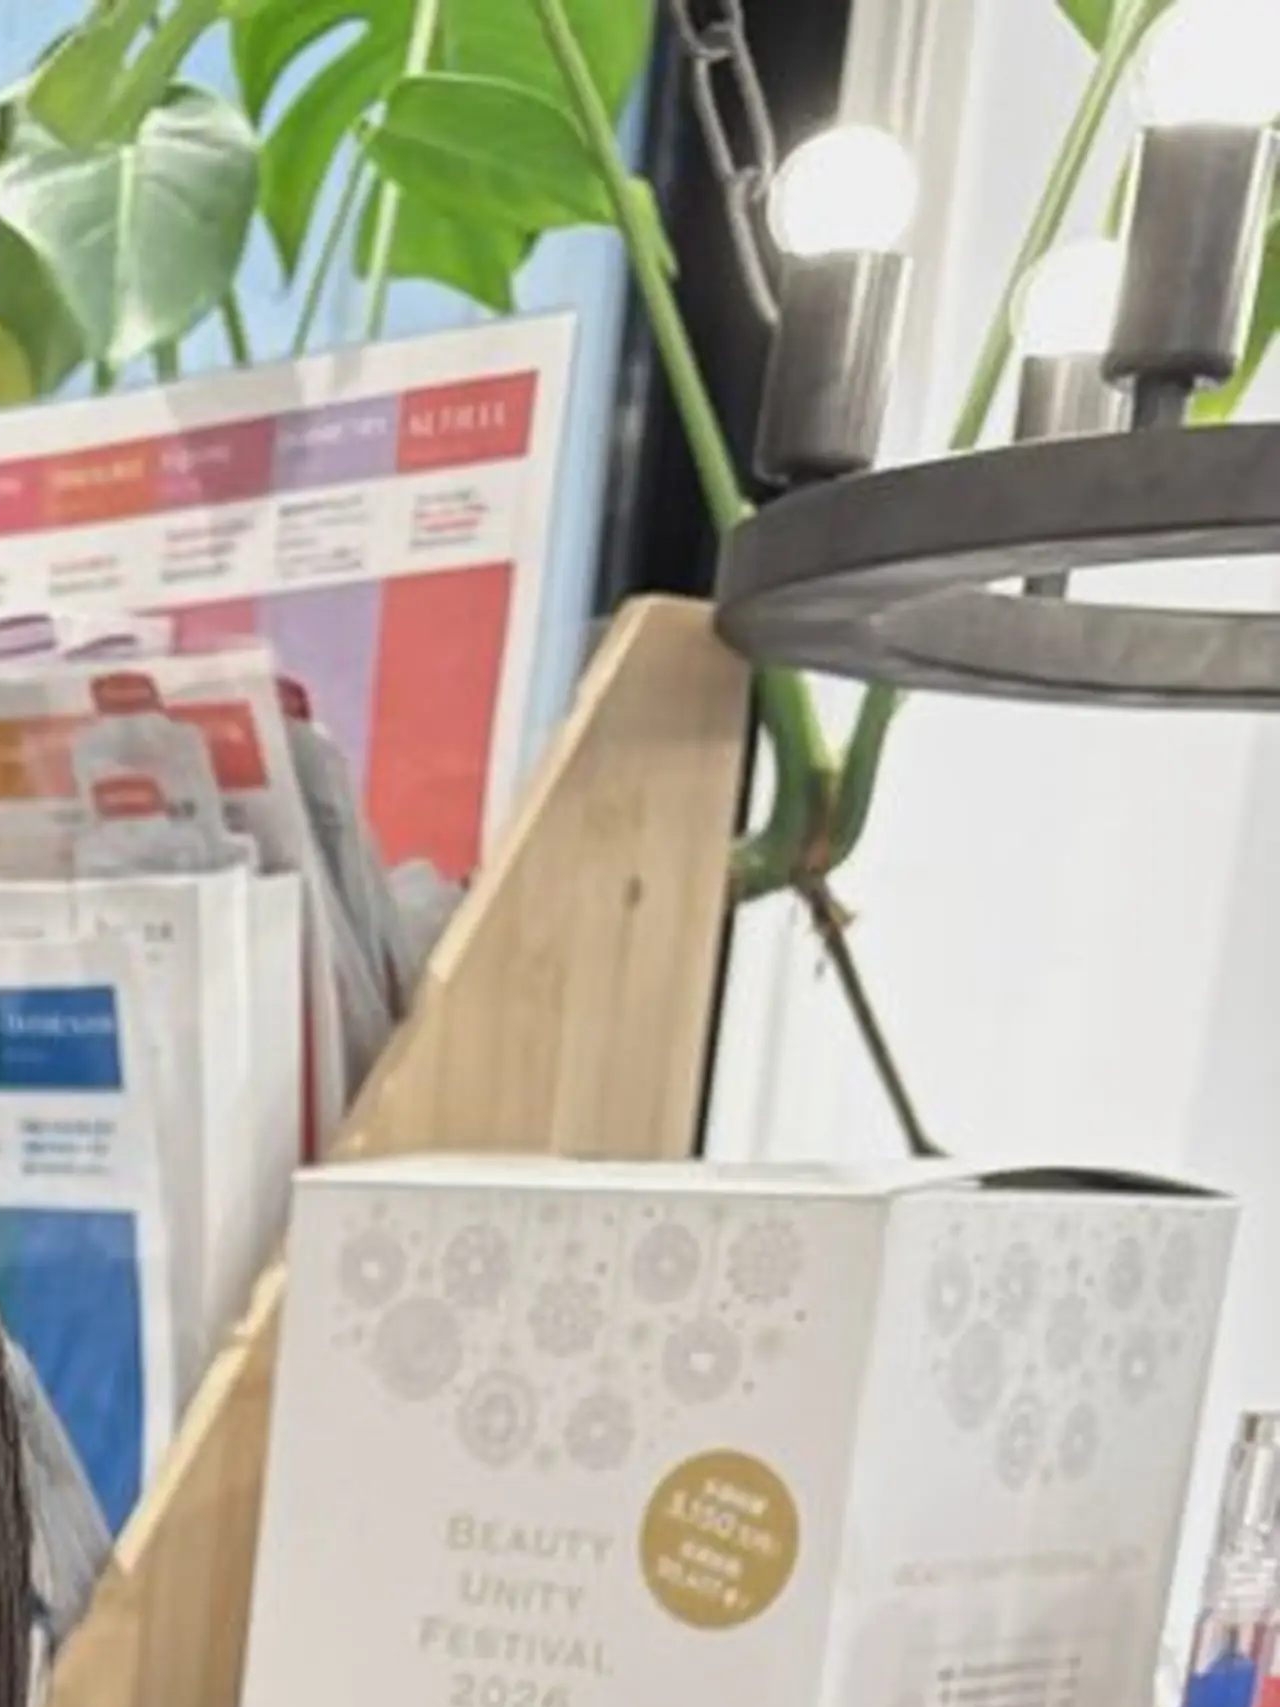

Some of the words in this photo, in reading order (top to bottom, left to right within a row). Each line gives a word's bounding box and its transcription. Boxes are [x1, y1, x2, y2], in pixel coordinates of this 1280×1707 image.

[446, 1514, 615, 1565] BEAUTY
[458, 1570, 585, 1615] UNITY
[417, 1616, 615, 1677] FESTIVAL
